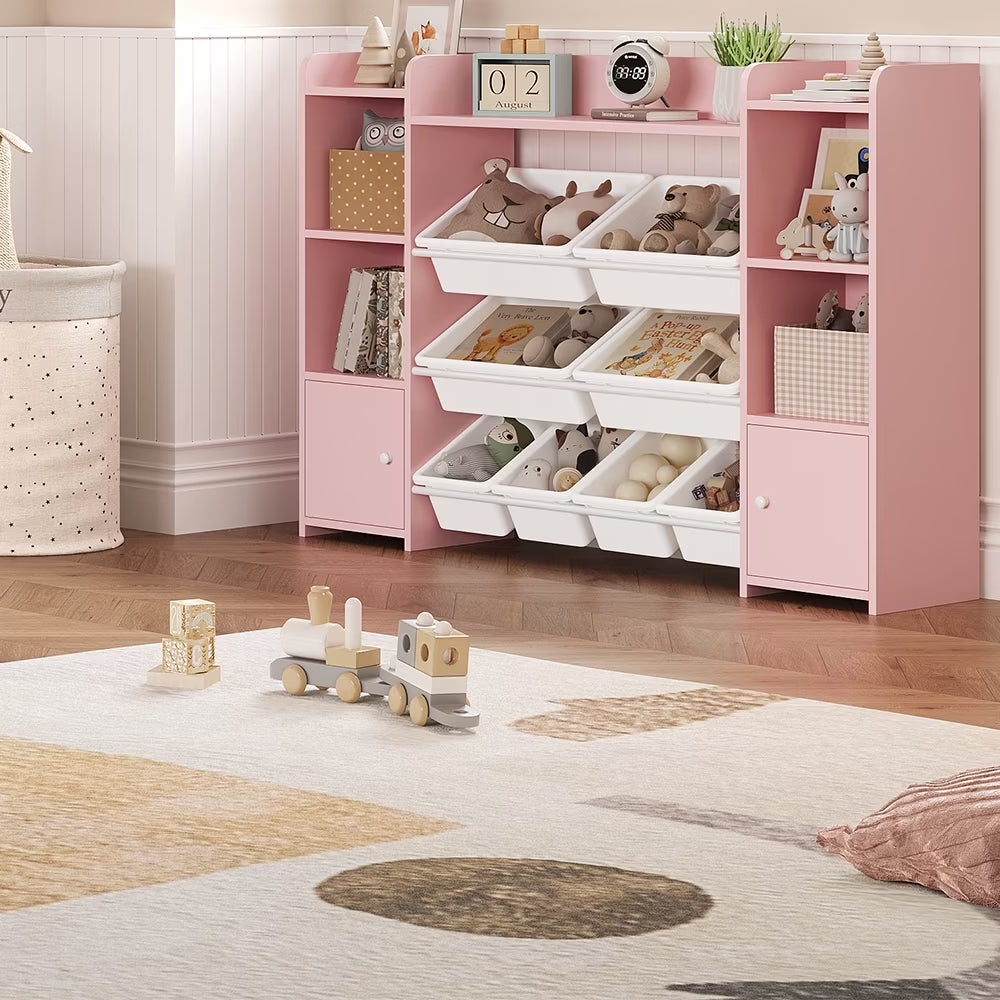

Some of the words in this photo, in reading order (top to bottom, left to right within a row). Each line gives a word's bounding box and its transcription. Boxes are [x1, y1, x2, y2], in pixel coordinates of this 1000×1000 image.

[495, 100, 532, 110] August
[661, 320, 702, 331] Pop-up
[640, 329, 690, 341] Easter
[665, 340, 697, 352] Hunt
